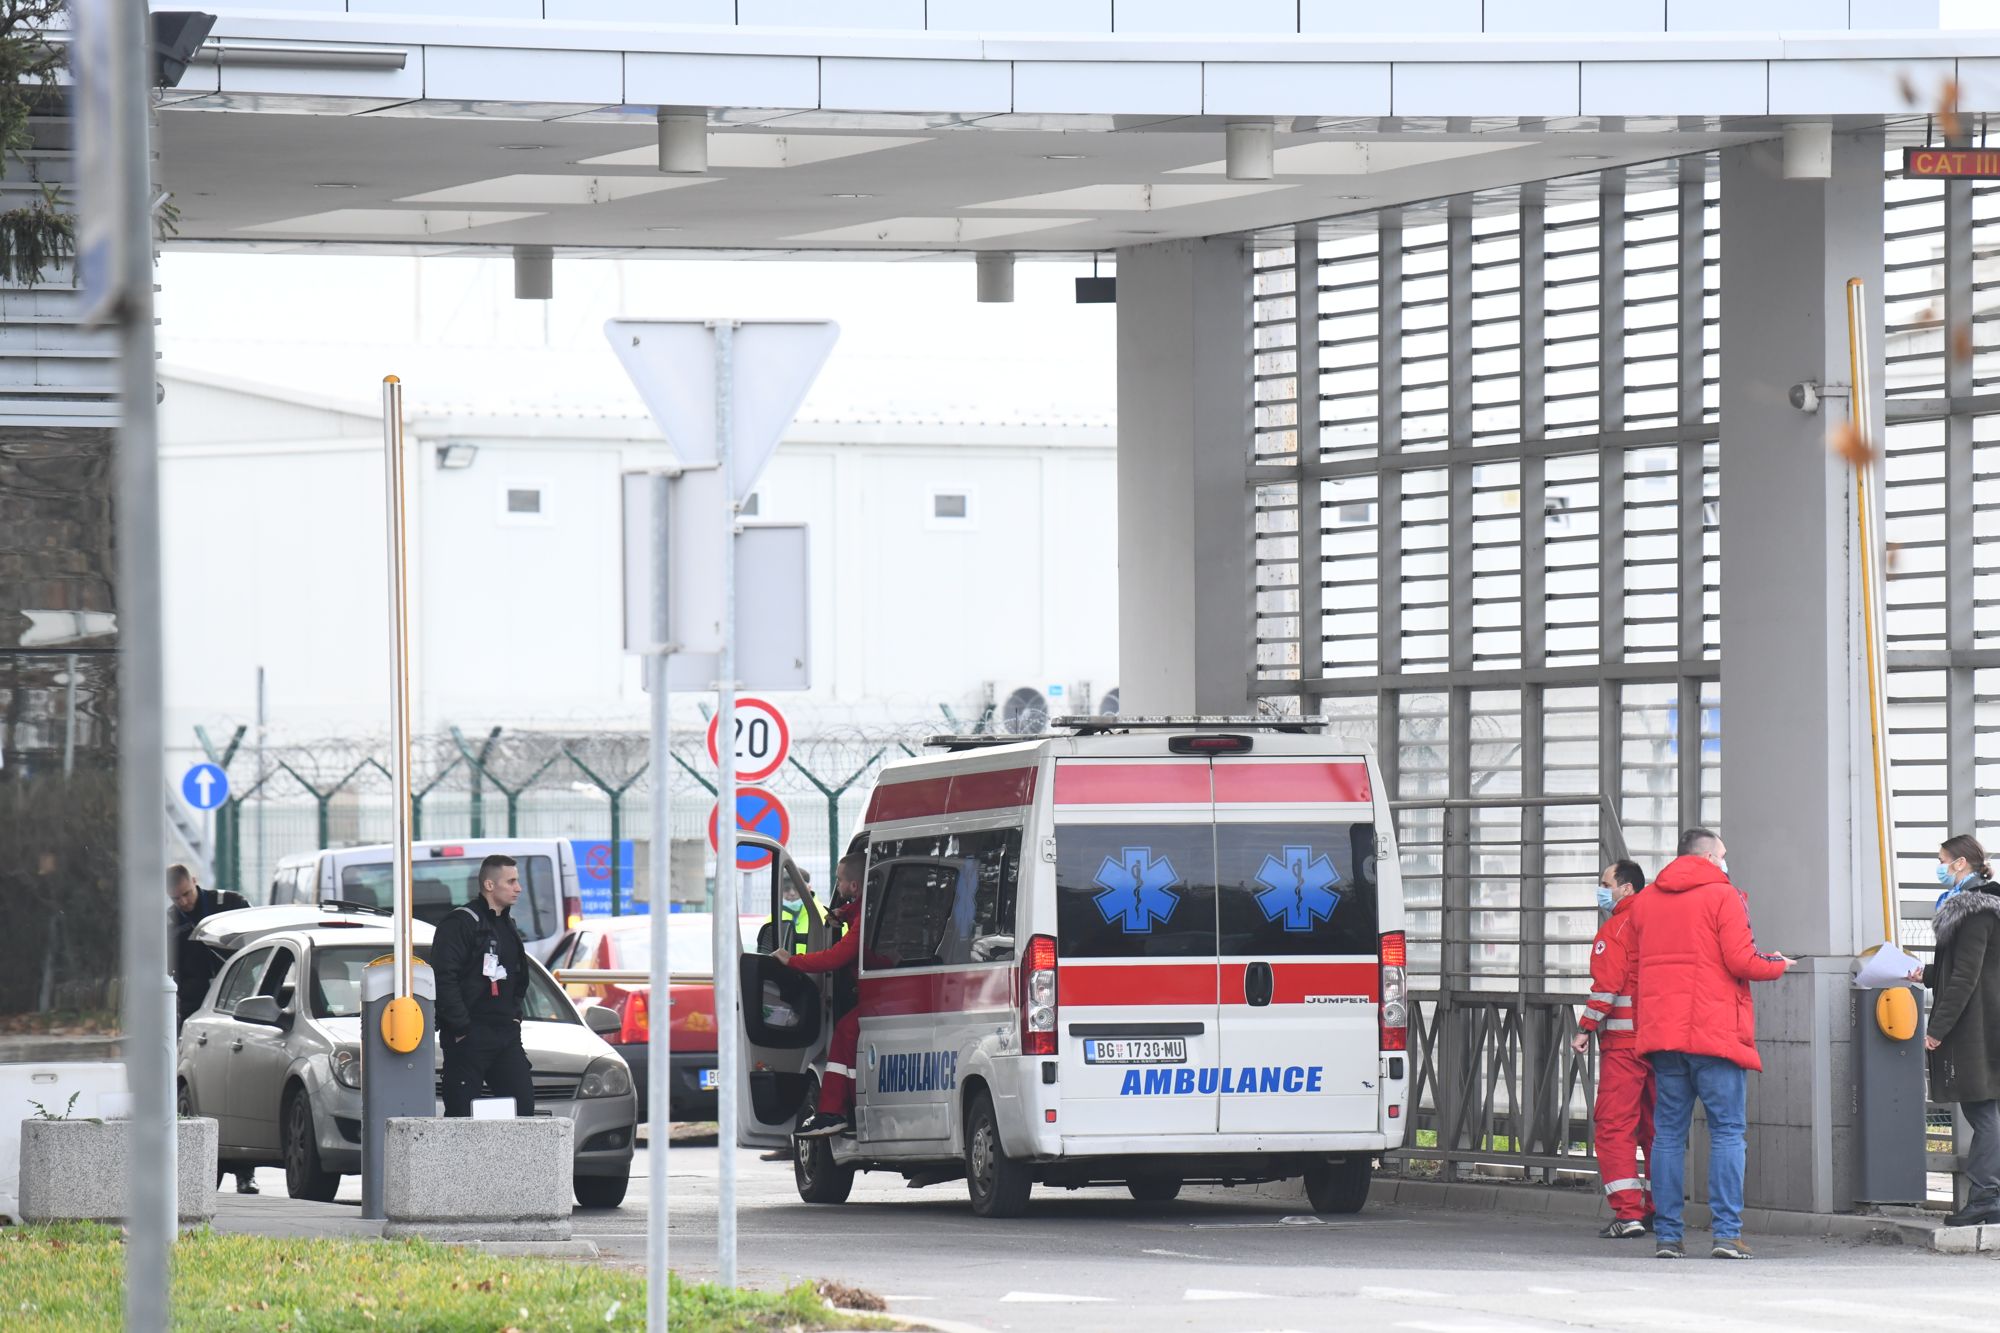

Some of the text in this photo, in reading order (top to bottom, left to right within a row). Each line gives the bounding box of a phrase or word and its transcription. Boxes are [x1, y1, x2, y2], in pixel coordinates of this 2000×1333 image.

[1917, 154, 1998, 174] CAT III
[1097, 1042, 1115, 1058] BG
[878, 1050, 958, 1094] AMBULANCE
[1120, 1066, 1323, 1096] AMBULANCE
